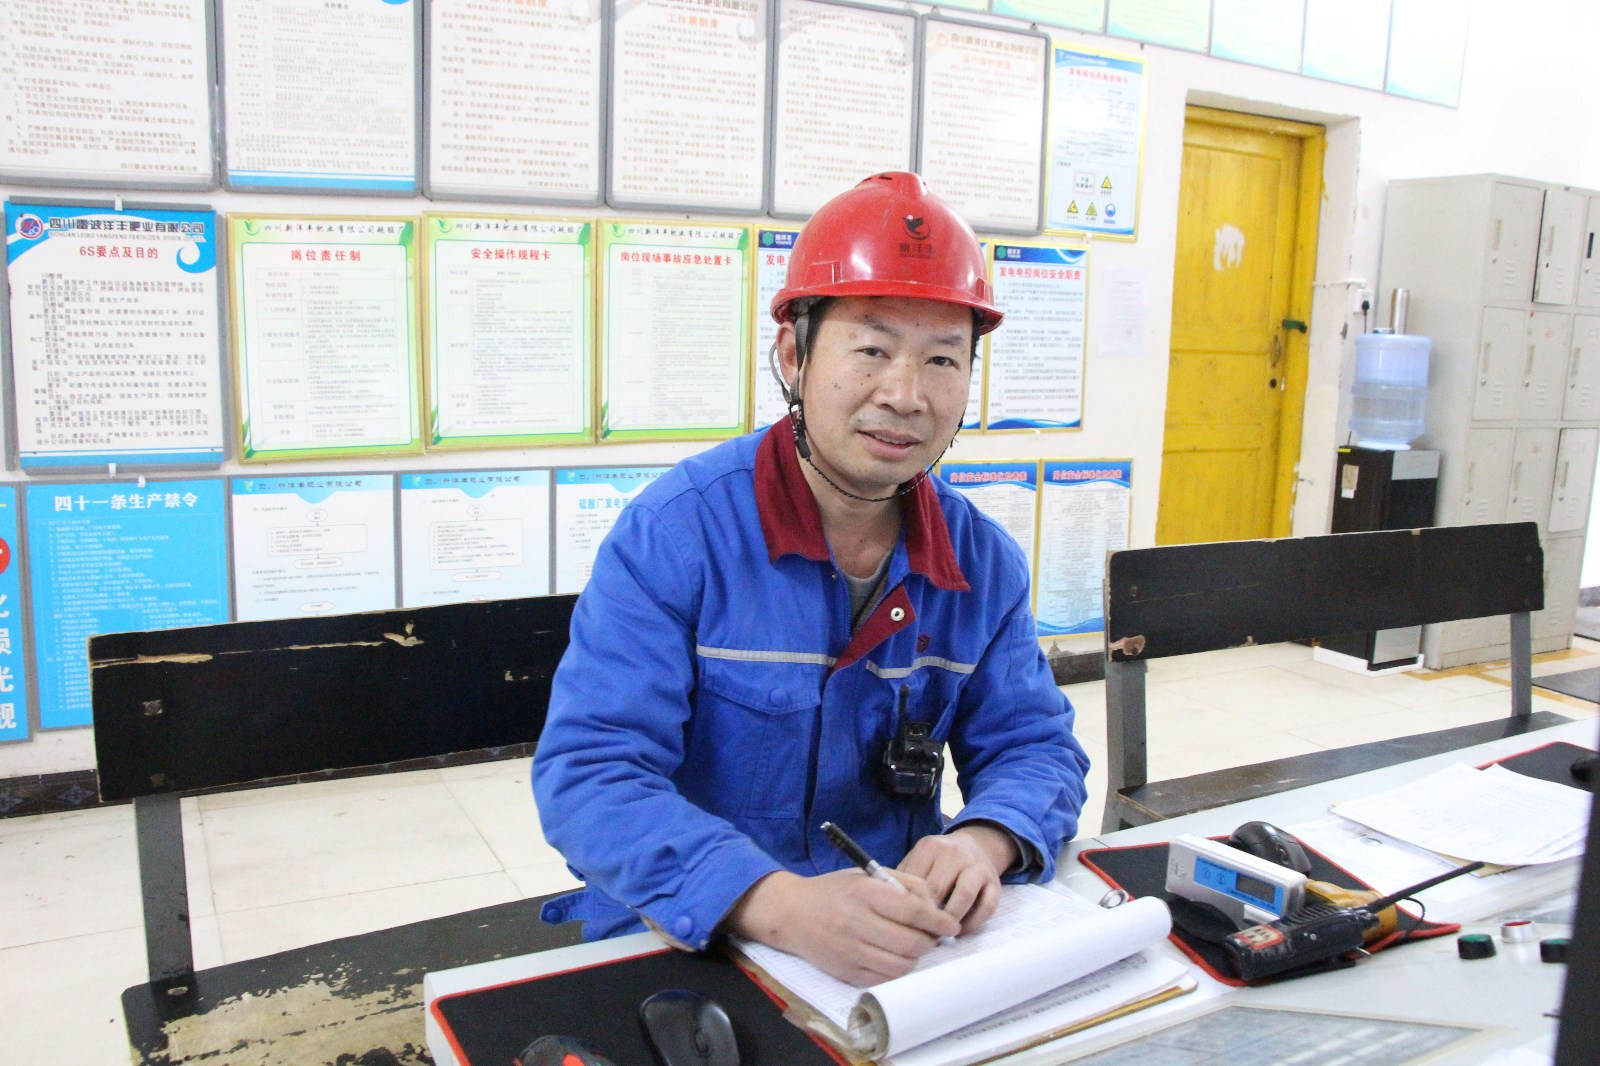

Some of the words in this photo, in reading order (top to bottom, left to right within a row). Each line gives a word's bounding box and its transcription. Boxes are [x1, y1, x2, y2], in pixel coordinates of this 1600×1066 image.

[49, 217, 205, 234] 四川雷波洋丰肥业有限公司
[79, 245, 159, 259] 6S要点及目的
[290, 249, 361, 262] 岗位责任制
[471, 247, 553, 261] 安全操作规程卡
[620, 251, 733, 266] 岗位现场事故应急处置卡
[54, 492, 199, 512] 四十一条生产禁令
